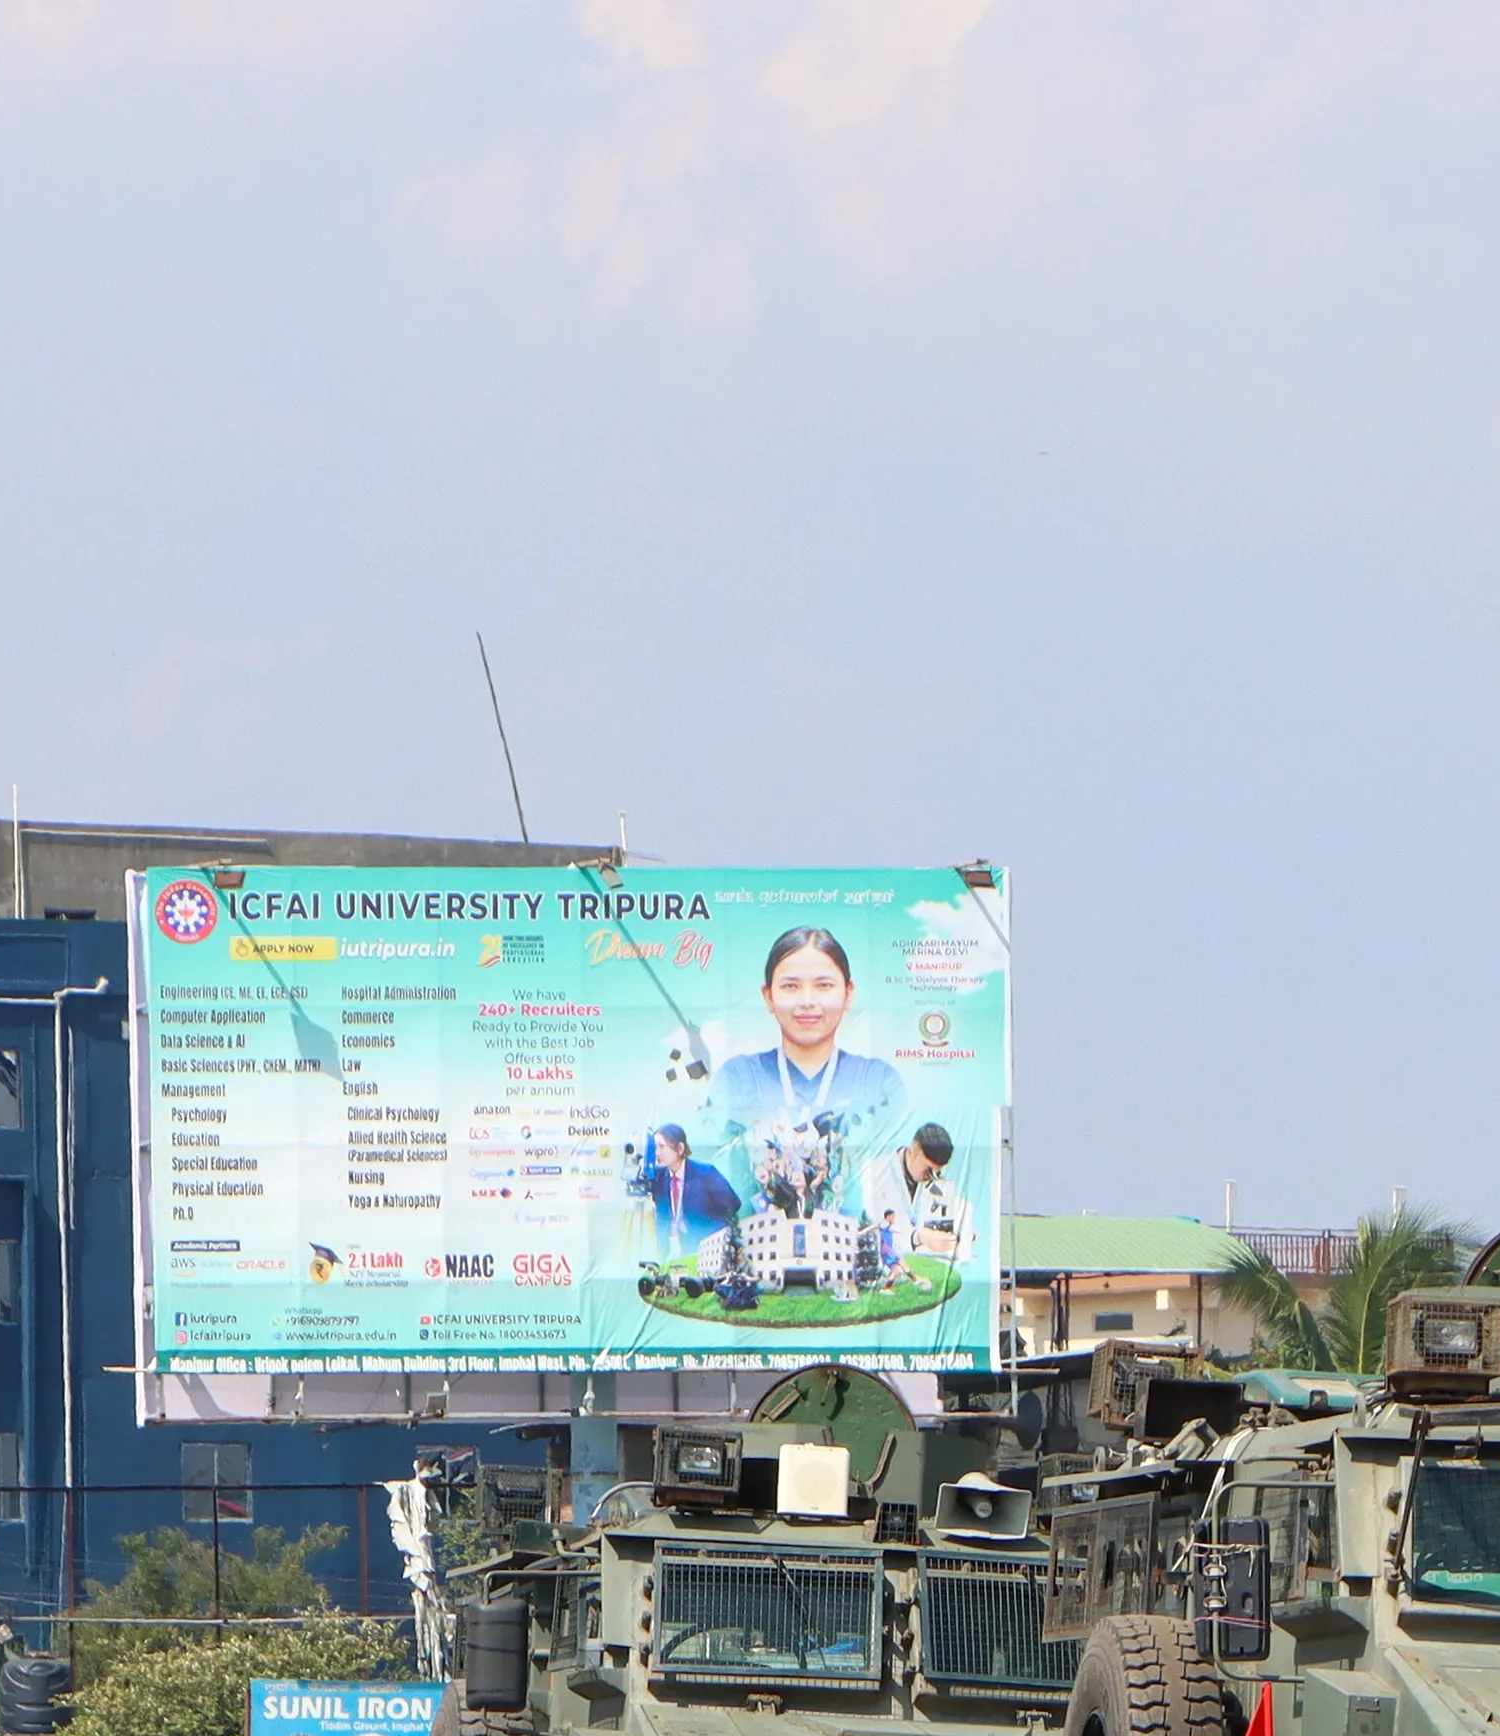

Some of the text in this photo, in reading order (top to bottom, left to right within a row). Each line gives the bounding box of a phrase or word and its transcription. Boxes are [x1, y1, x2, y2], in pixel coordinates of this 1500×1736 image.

[228, 892, 320, 919] ICFAI
[336, 892, 543, 919] UNIVERSITY
[557, 893, 711, 920] TRIPURA
[252, 944, 315, 954] APPLY NOW
[340, 937, 456, 960] iutripura.in
[585, 929, 666, 966] Dream
[673, 929, 714, 970] Big
[160, 985, 218, 1000] Engineering
[341, 985, 457, 1001] Hospital Administration
[512, 989, 566, 1001] We have
[479, 1003, 601, 1016] 240+ Recruiters
[160, 1009, 266, 1027] Computer Application
[341, 1010, 395, 1025] Commerce
[472, 1020, 604, 1034] Ready to Provide You
[160, 1034, 182, 1048] Data
[184, 1034, 225, 1048] Science
[235, 1034, 246, 1048] AI
[341, 1034, 395, 1048] Economics
[484, 1037, 595, 1049] with the Best Job
[504, 1053, 576, 1067] Offers upto
[895, 1049, 975, 1061] RIMS Hospital
[161, 1058, 188, 1073] Basic
[190, 1058, 235, 1073] Sciences
[342, 1058, 362, 1072] Law
[506, 1067, 574, 1080] 10 Lakhs
[161, 1084, 226, 1098] Management
[342, 1081, 378, 1096] English
[505, 1086, 575, 1098] per annum
[171, 1107, 227, 1123] Psychology
[347, 1106, 440, 1122] Clinical Psychology
[569, 1105, 610, 1120] IndiGo
[348, 1130, 447, 1145] Allied Health Science
[568, 1126, 610, 1137] Deloitte
[172, 1132, 220, 1147] Education
[347, 1149, 448, 1163] (Paramedical Sciences)
[524, 1146, 555, 1160] wipro
[172, 1156, 258, 1173] Special Education
[348, 1170, 385, 1185] Nursing
[172, 1181, 264, 1198] Physical Education
[348, 1194, 372, 1209] Yoga
[382, 1194, 441, 1209] Naturopathy
[170, 1257, 197, 1269] aws
[236, 1260, 286, 1269] ORACLE
[348, 1252, 404, 1269] 2.1 Lakh
[445, 1254, 496, 1278] NAAC
[512, 1254, 572, 1274] GIGA
[514, 1275, 573, 1287] CAMPUS
[433, 1314, 582, 1325] ICFAI UNIVERSITY TRIPURA
[432, 1329, 451, 1340] Toll
[453, 1329, 477, 1340] Free
[479, 1329, 497, 1340] No.
[170, 1357, 215, 1373] Manipur
[216, 1357, 247, 1373] Office
[403, 1356, 446, 1372] Building
[448, 1356, 467, 1372] 3rd
[499, 1356, 536, 1371] Imphal
[263, 1695, 433, 1720] SUNIL IRON
[353, 1721, 391, 1732] Ground,
